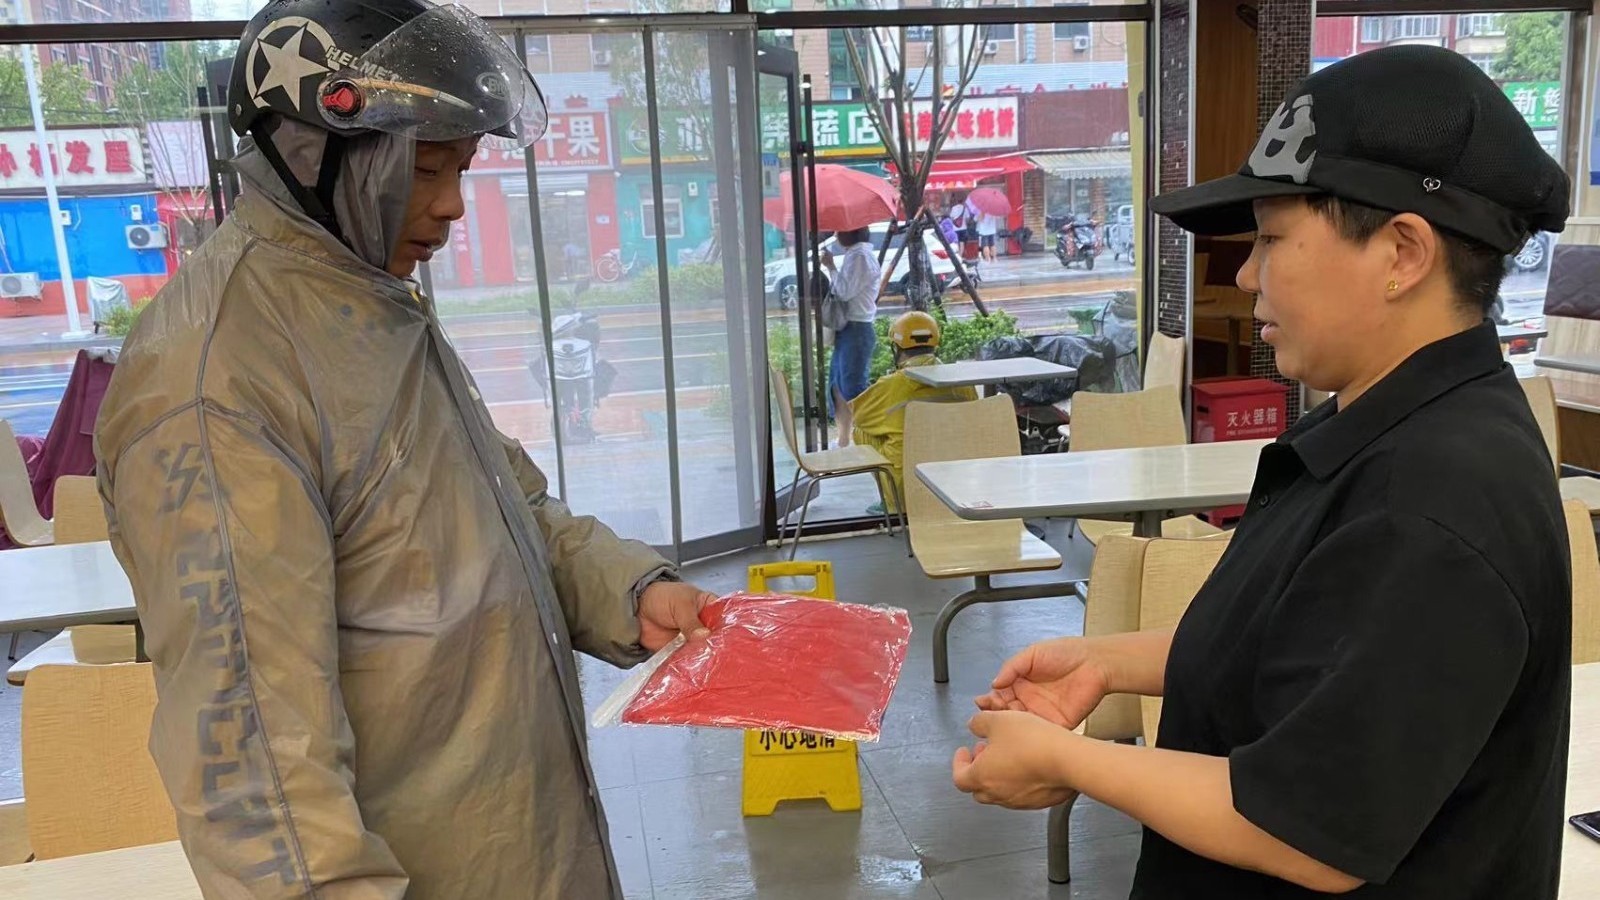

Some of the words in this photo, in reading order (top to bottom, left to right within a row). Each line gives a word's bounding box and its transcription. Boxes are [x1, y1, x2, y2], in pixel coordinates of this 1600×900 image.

[325, 45, 400, 86] HELMET
[1226, 407, 1278, 428] 灭火器箱
